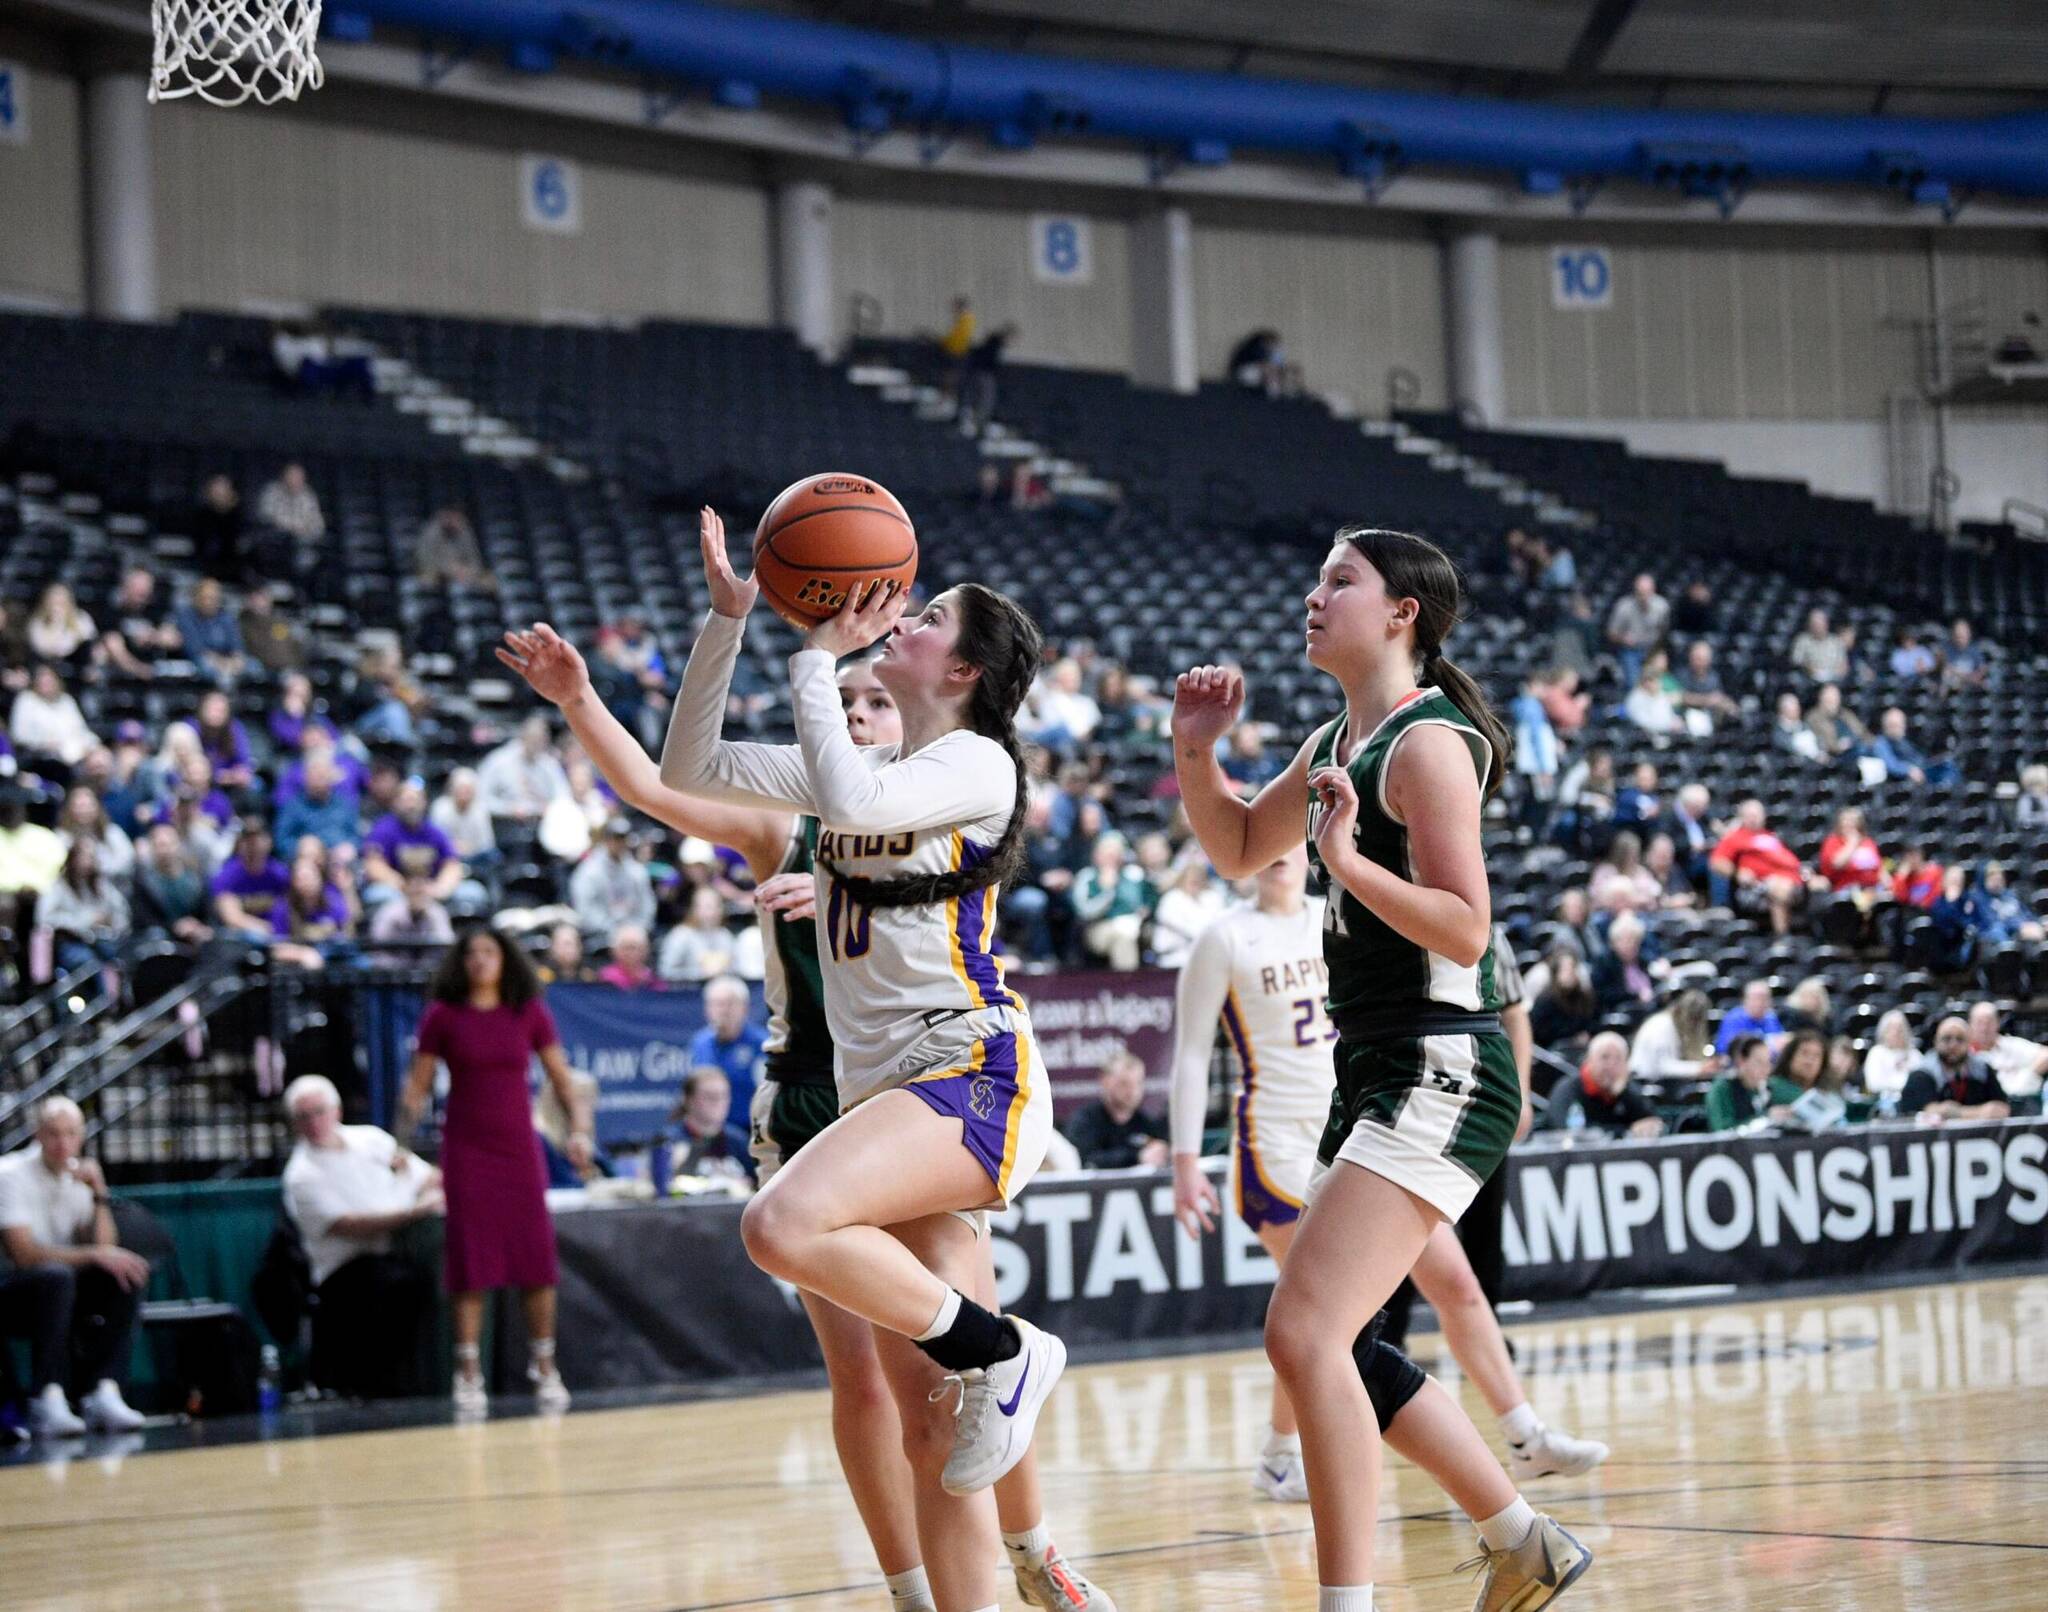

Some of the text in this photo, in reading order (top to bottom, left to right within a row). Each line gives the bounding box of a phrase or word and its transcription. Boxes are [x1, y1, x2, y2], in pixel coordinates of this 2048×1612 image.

[533, 161, 568, 220] 6
[1046, 223, 1078, 272] 8
[1558, 252, 1608, 300] 10
[1261, 956, 1329, 996] RAPI
